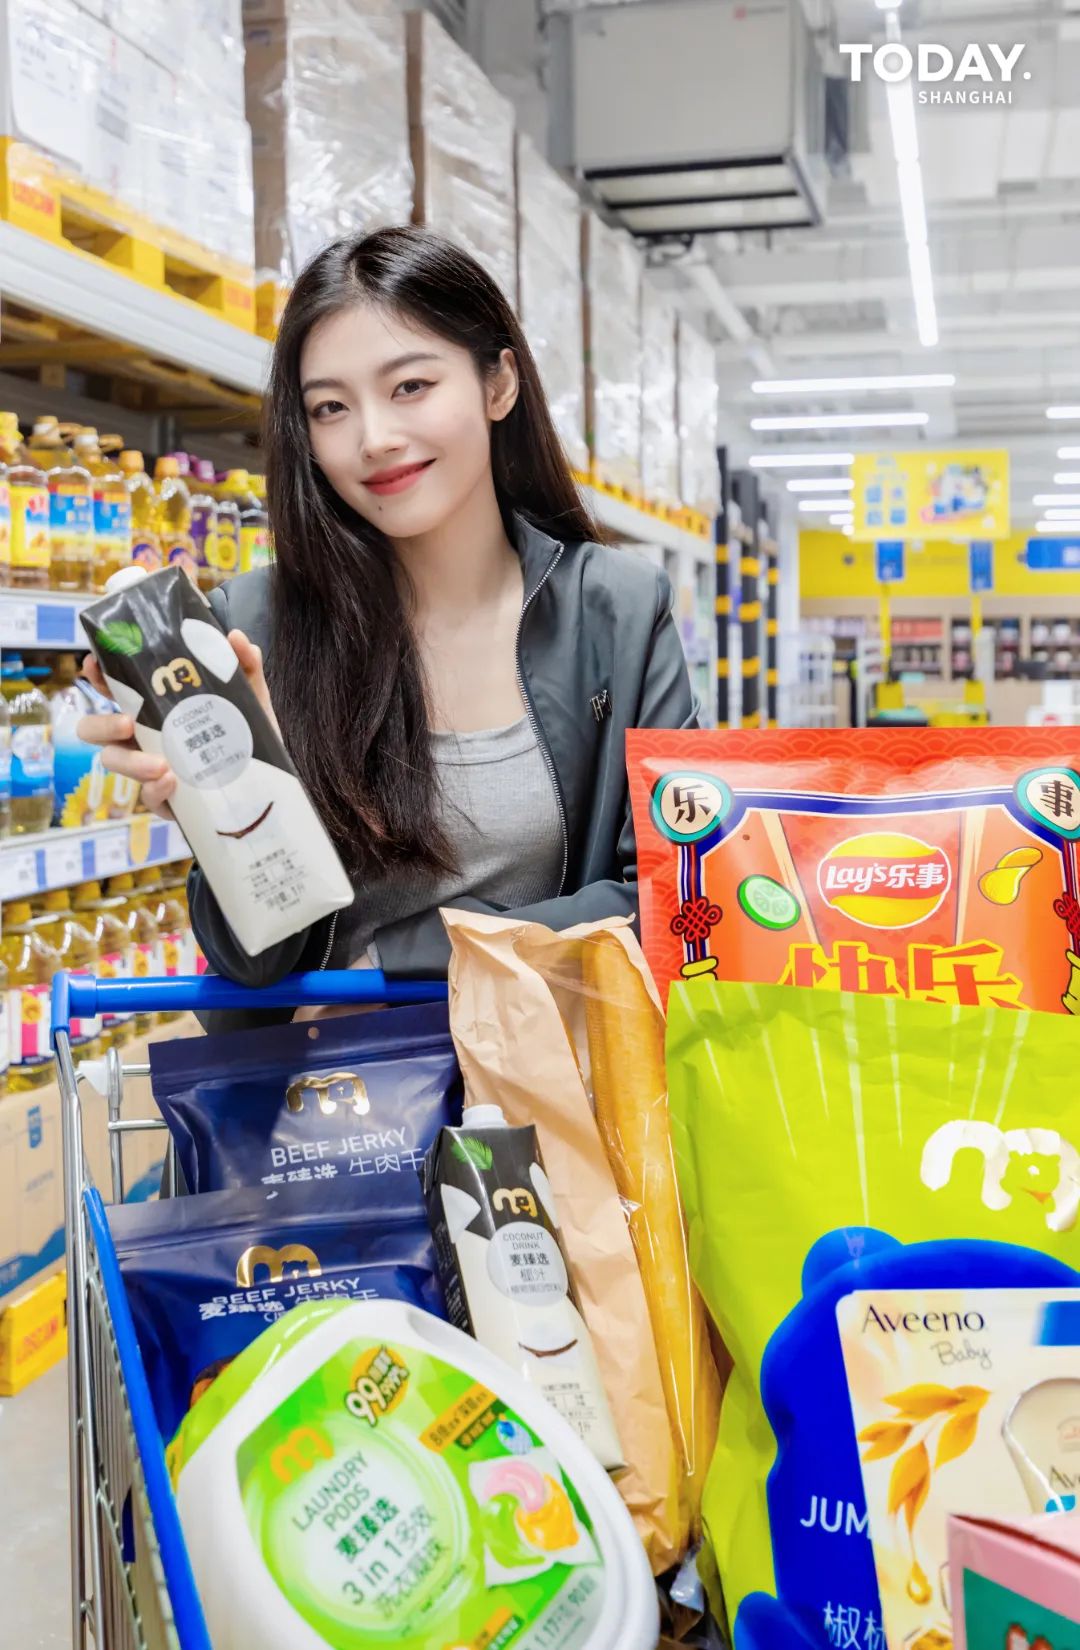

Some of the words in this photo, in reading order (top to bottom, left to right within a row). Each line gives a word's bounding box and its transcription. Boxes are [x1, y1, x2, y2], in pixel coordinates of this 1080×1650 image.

[172, 700, 214, 727] COCONUT
[184, 715, 211, 733] DRINK
[672, 783, 711, 825] 乐
[1038, 779, 1074, 818] 事
[271, 1141, 330, 1167] BEEF
[336, 1126, 406, 1155] JERKY
[503, 1232, 543, 1241] COCONUT
[512, 1242, 540, 1250] DRINK
[212, 1288, 276, 1305] BEEF
[284, 1277, 360, 1297] JERKY
[861, 1303, 986, 1333] Aveeno
[931, 1341, 993, 1369] Baby
[292, 1450, 368, 1532] LAUNDRY
[323, 1482, 370, 1532] PODS
[342, 1581, 364, 1606] 3
[357, 1560, 389, 1587] in
